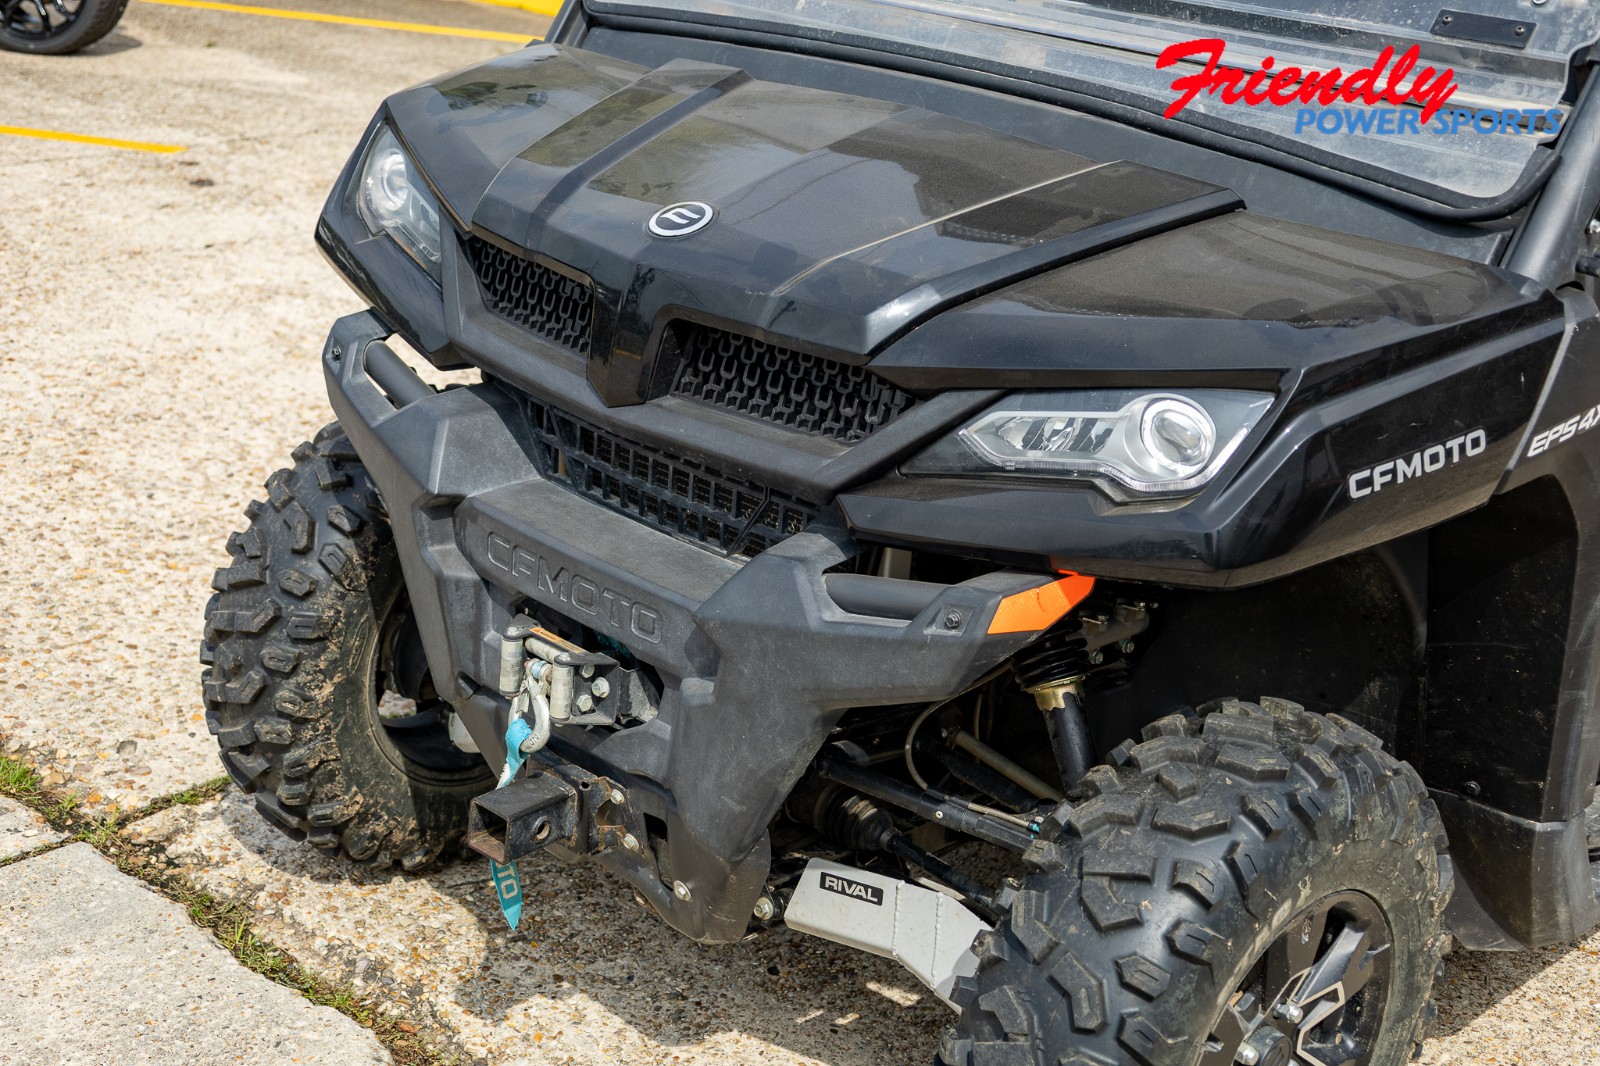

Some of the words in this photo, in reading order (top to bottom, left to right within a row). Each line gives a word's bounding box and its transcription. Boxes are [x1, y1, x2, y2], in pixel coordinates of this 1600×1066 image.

[1349, 428, 1487, 499] CFMOTO
[487, 531, 663, 645] CFMOTO
[825, 876, 878, 903] RIVAL
